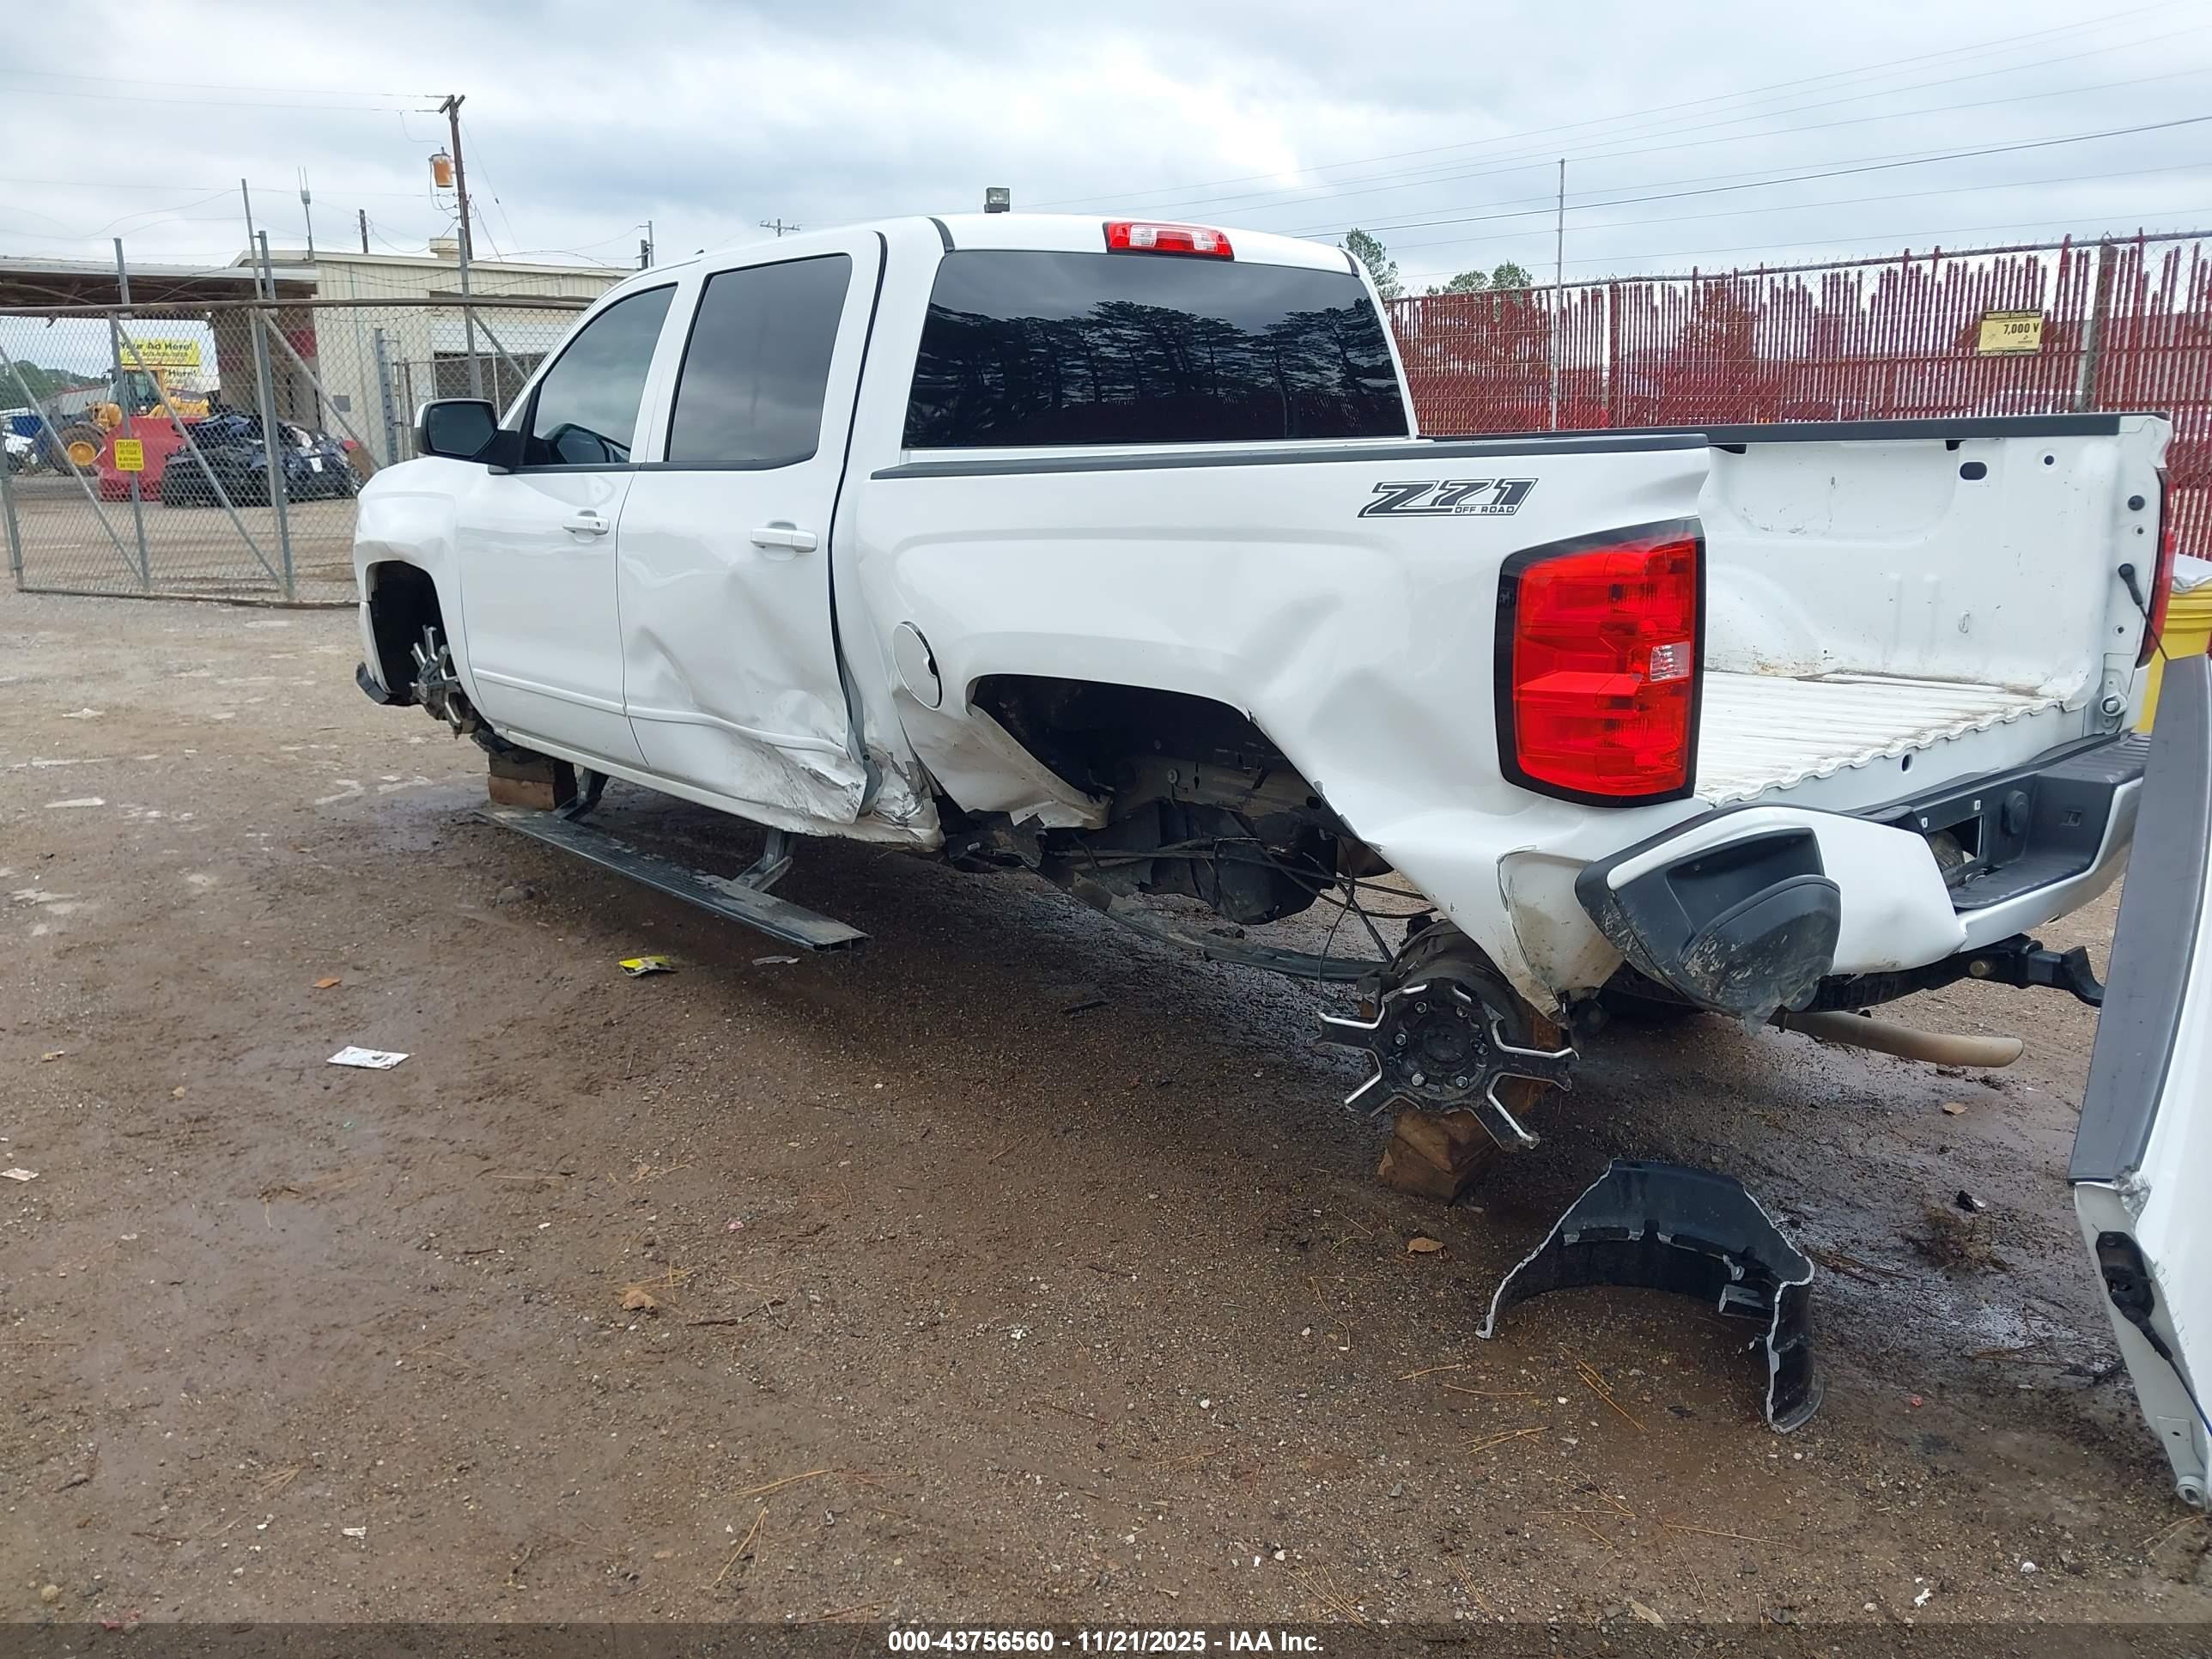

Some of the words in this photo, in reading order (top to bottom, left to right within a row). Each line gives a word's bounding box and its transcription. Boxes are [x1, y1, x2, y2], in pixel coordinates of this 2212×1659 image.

[2003, 323, 2030, 336] 7,000
[2033, 322, 2039, 332] V
[148, 342, 161, 350] Ad
[165, 342, 193, 351] Here!
[1357, 478, 1539, 518] Z71
